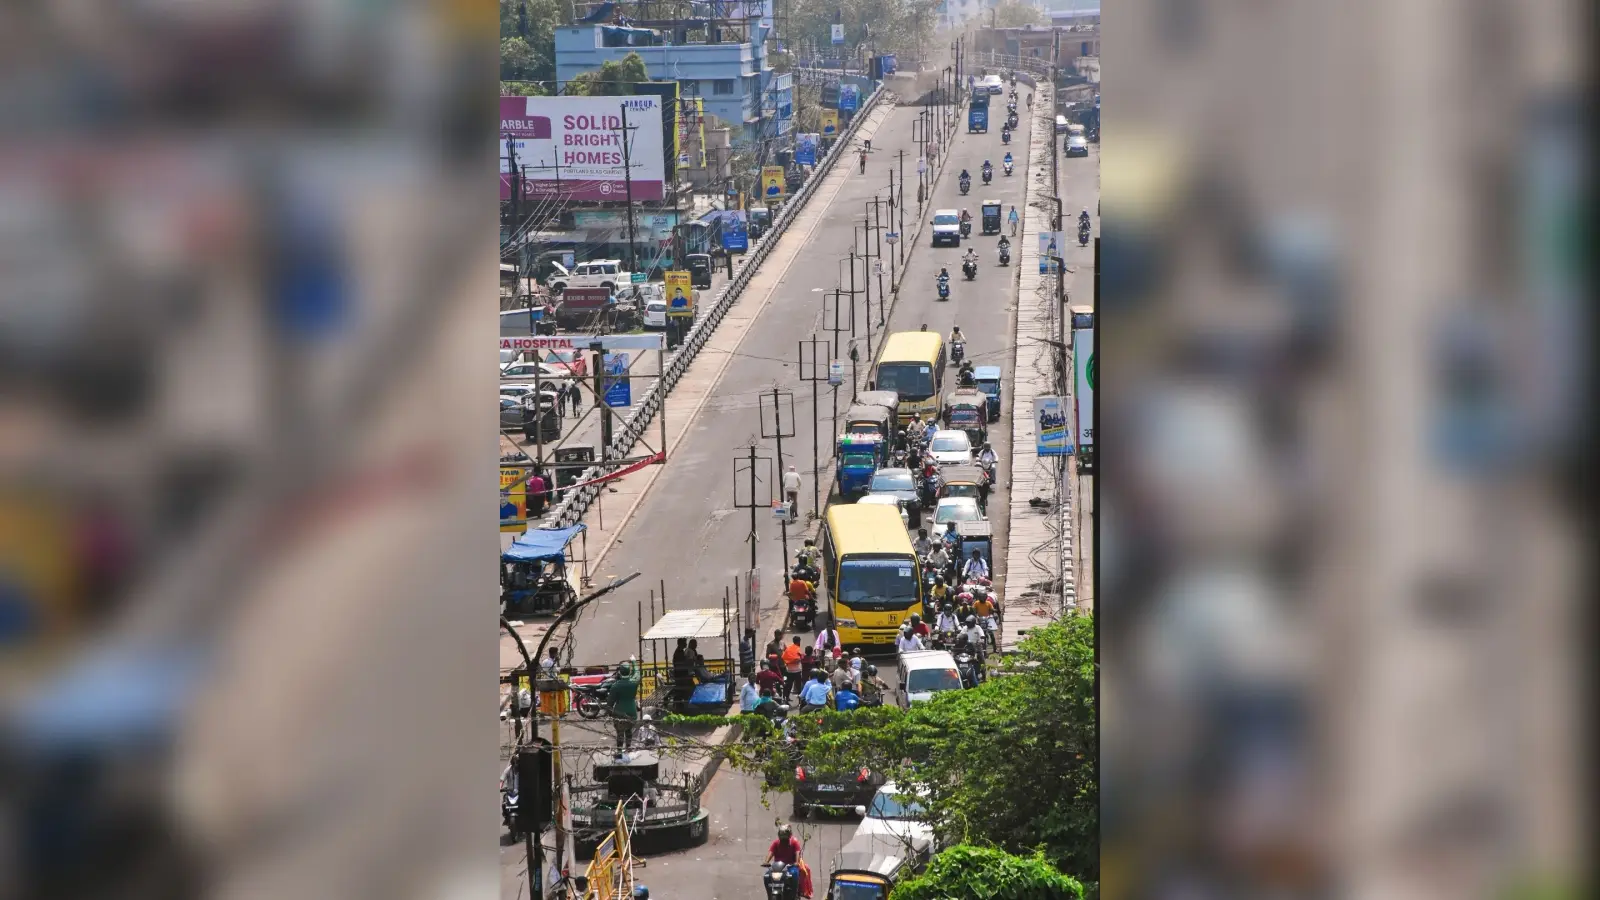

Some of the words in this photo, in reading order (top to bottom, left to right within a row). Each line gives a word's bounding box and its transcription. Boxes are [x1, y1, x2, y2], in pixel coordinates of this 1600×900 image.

[500, 120, 535, 130] ARBLE
[564, 115, 620, 130] SOLID
[564, 135, 620, 146] BRIGHT
[564, 152, 621, 165] HOMES
[500, 340, 511, 349] A
[514, 339, 573, 349] HOSPITAL
